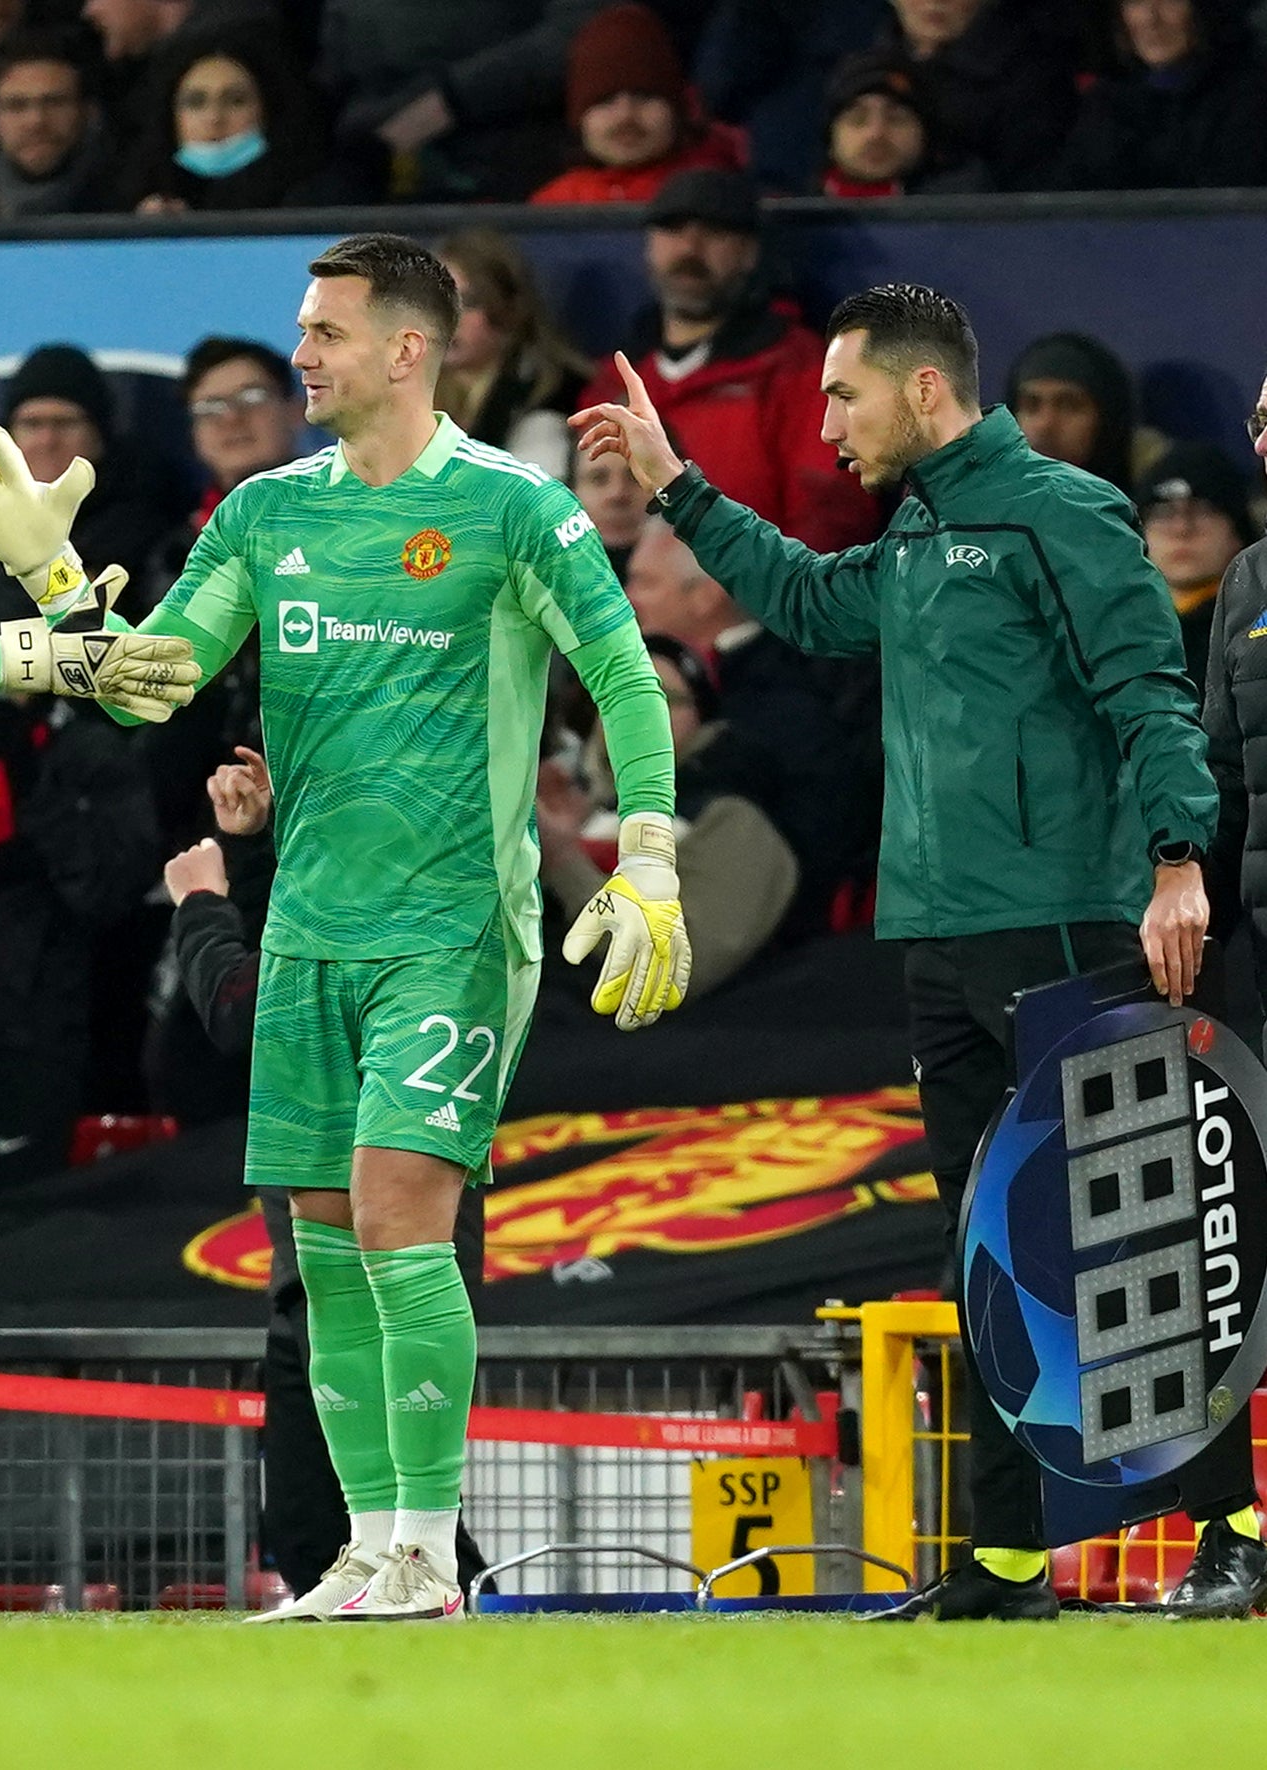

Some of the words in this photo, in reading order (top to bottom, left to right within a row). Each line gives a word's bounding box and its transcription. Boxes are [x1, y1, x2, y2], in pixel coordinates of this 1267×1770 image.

[274, 564, 311, 576] adidas
[945, 547, 984, 568] UEFA
[320, 616, 455, 650] TeamViewer
[402, 1014, 496, 1102] 22
[425, 1116, 461, 1133] adidas
[1194, 1080, 1243, 1353] HUBLOT
[719, 1472, 780, 1506] SSP
[730, 1514, 780, 1596] 5
